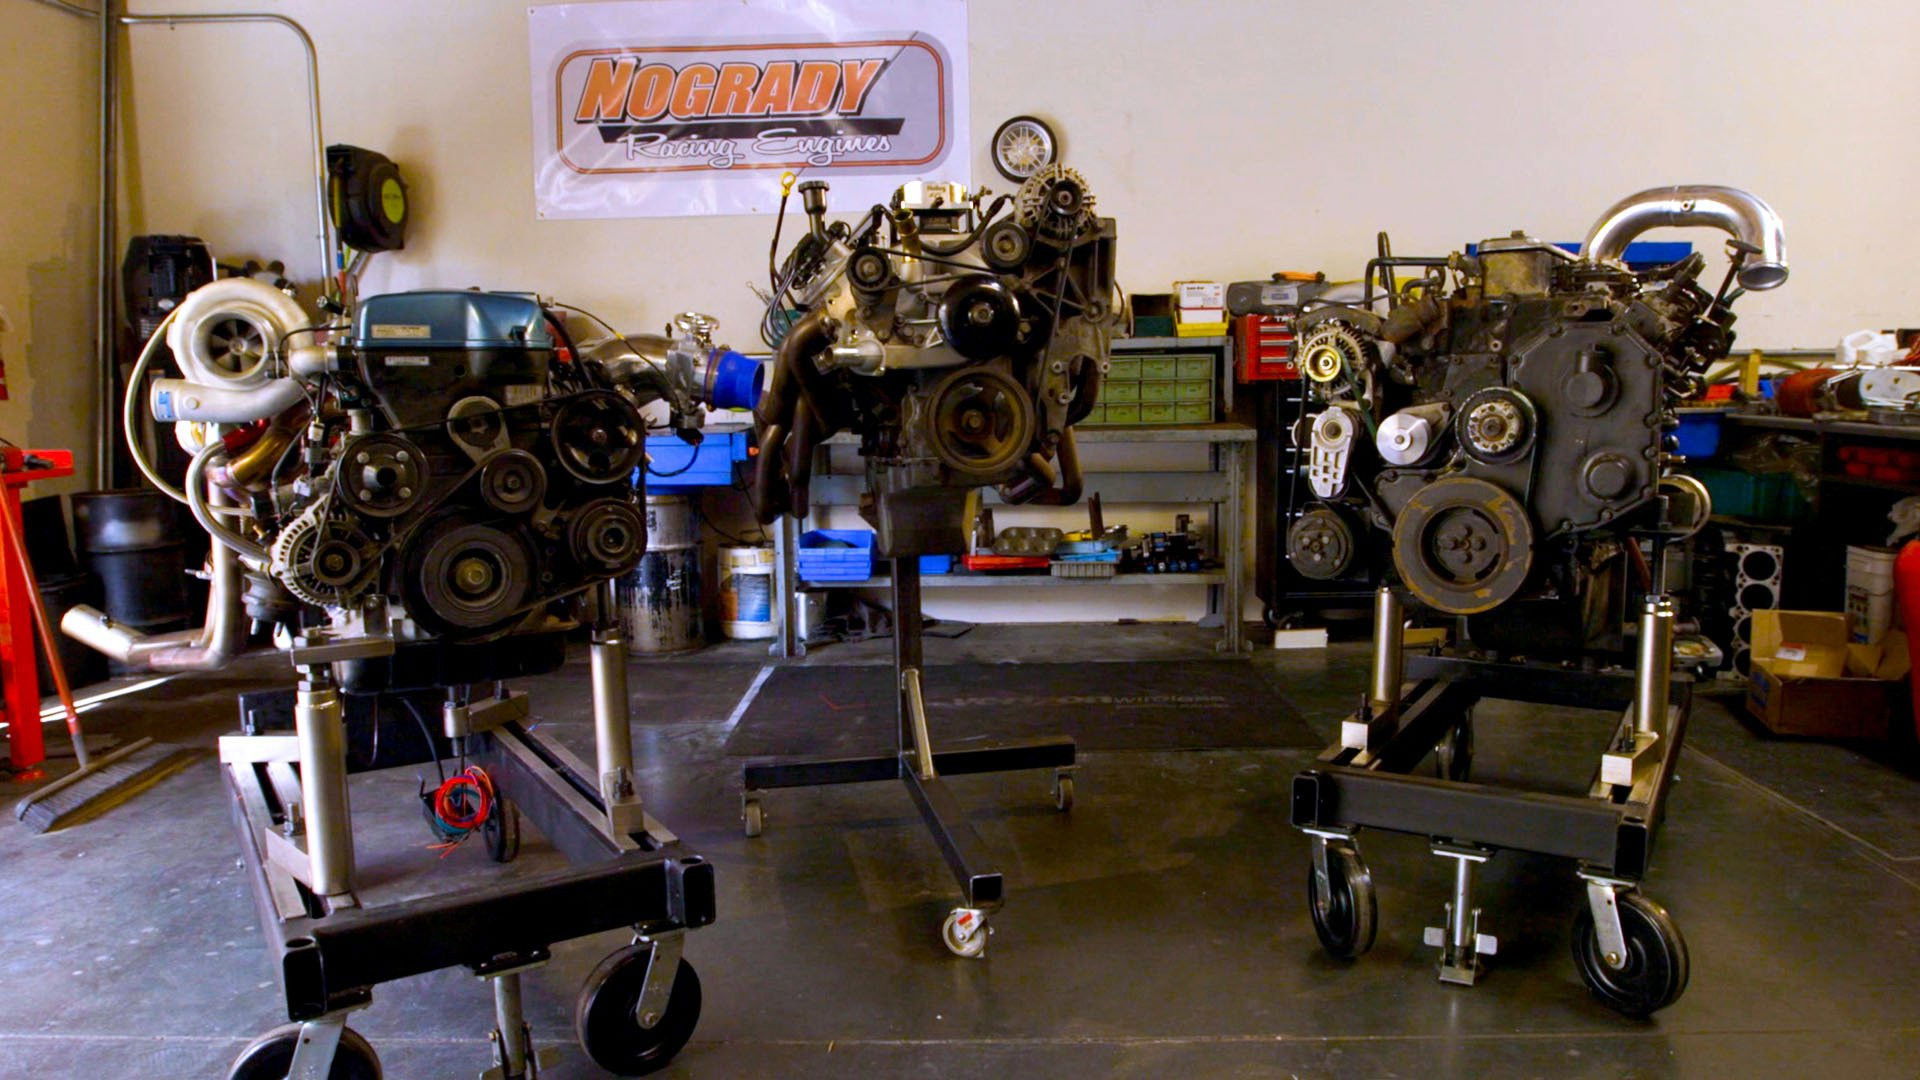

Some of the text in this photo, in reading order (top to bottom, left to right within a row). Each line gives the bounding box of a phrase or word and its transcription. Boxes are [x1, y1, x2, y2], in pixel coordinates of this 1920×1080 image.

[575, 57, 889, 124] NOGRADY
[616, 127, 891, 168] Racing Engines
